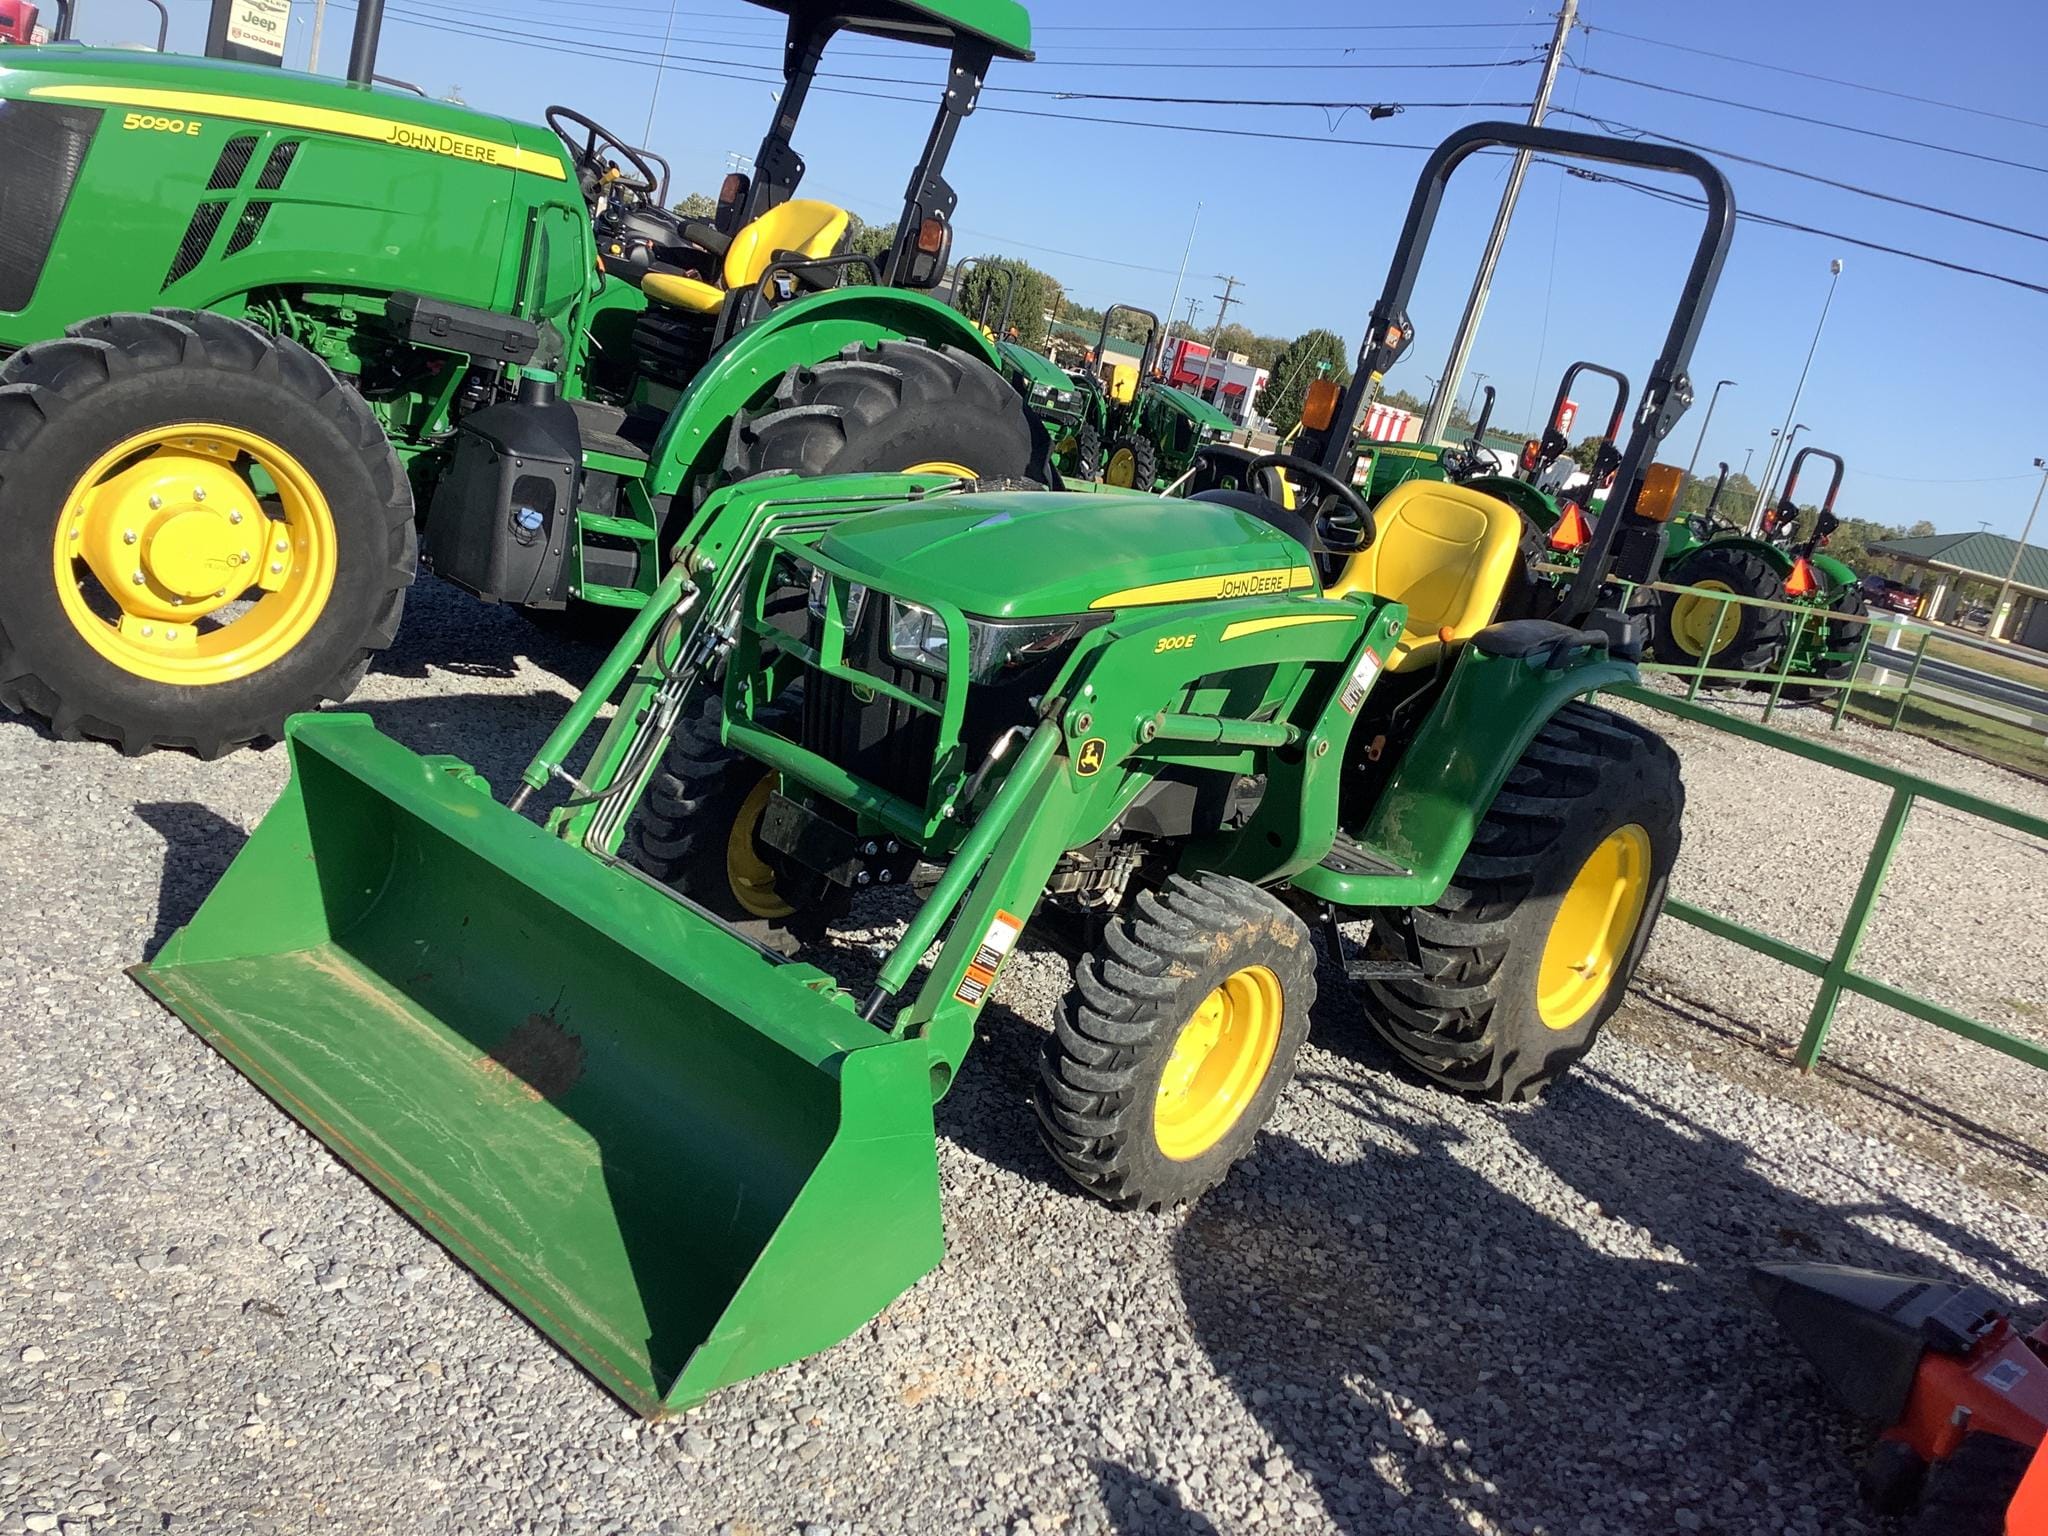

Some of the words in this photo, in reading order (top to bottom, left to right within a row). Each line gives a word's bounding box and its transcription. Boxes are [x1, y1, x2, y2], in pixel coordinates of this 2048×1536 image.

[242, 11, 277, 32] Jeep
[243, 32, 282, 48] DODGE
[386, 126, 436, 149] JOHN
[439, 136, 497, 162] DEERE
[1217, 579, 1249, 596] JOHN
[1250, 576, 1284, 592] DEERE
